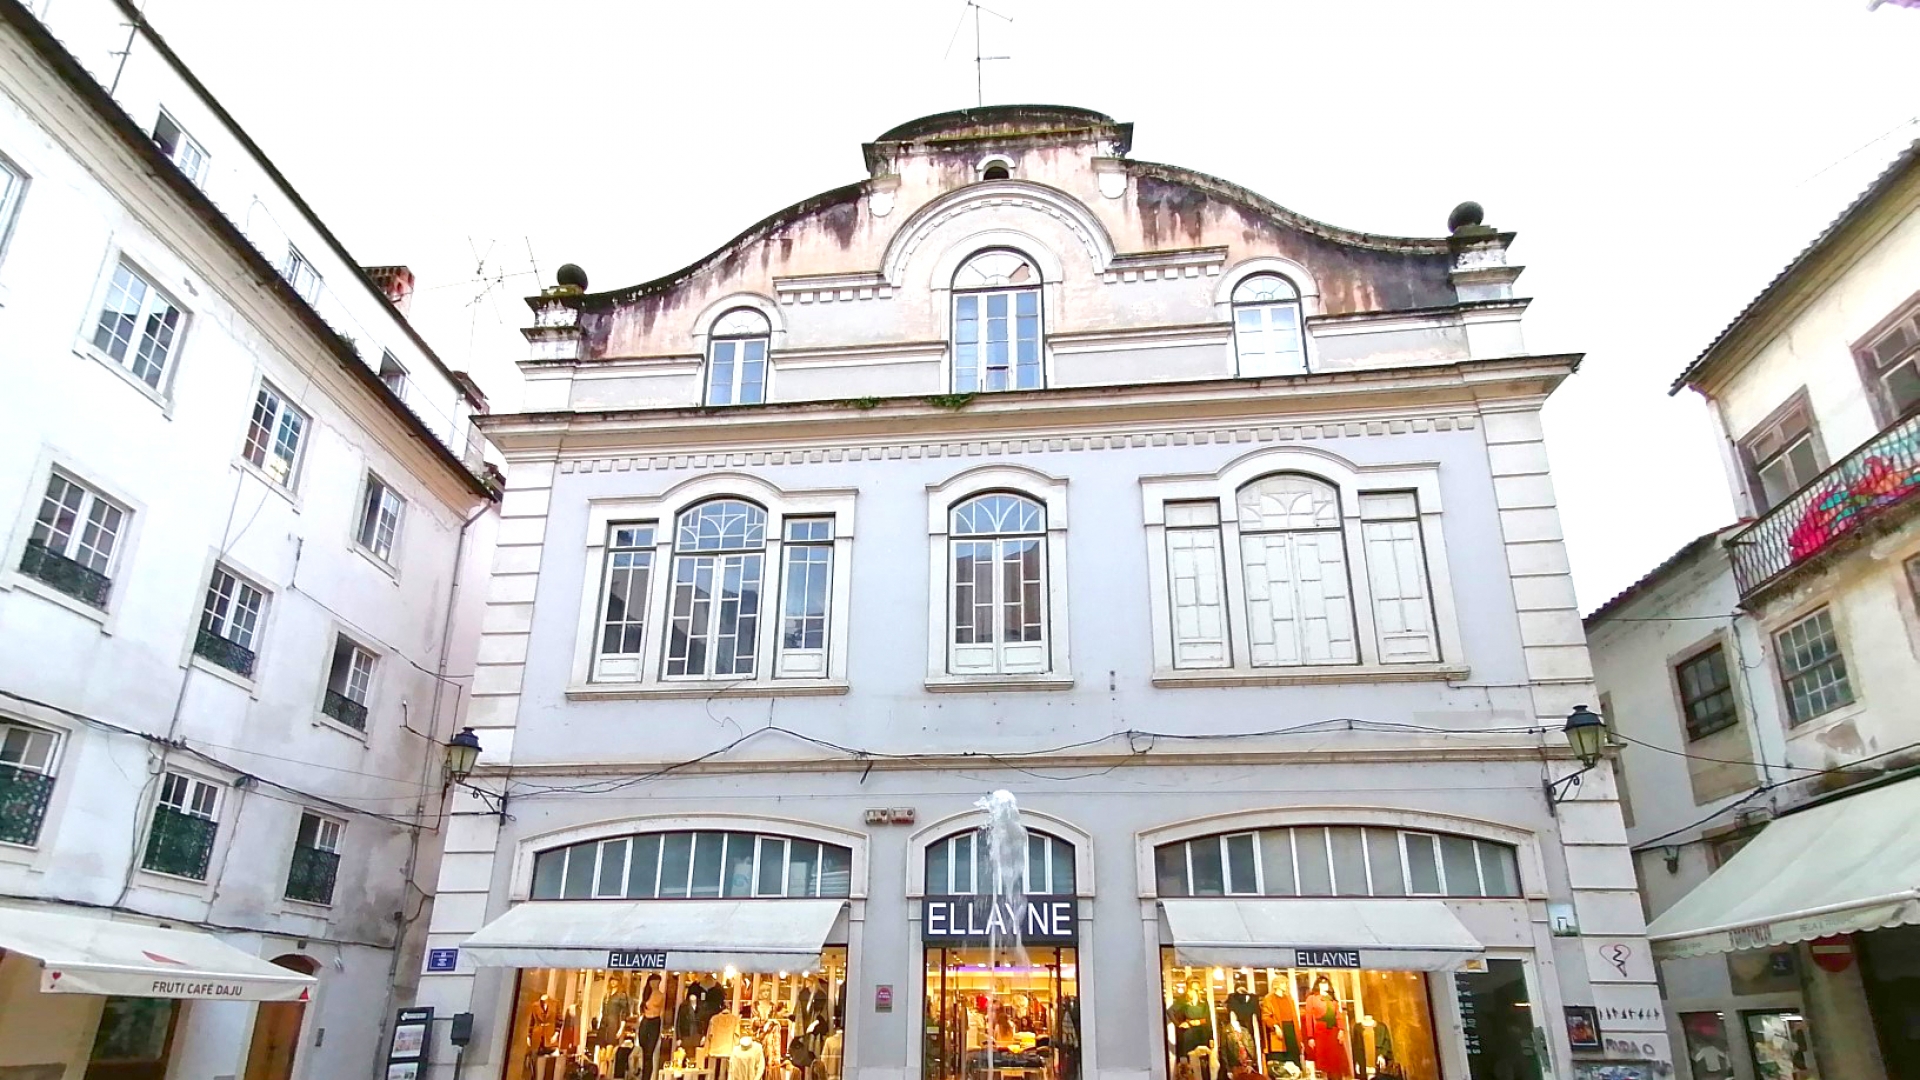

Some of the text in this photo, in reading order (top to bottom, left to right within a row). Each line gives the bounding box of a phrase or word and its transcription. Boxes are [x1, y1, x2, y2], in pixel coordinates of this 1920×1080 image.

[928, 902, 1072, 935] ELLAYNE
[610, 953, 665, 968] ELLAYNE
[1297, 952, 1358, 967] ELLAYNE
[152, 981, 185, 994] FRUTI
[215, 984, 243, 996] DAJU
